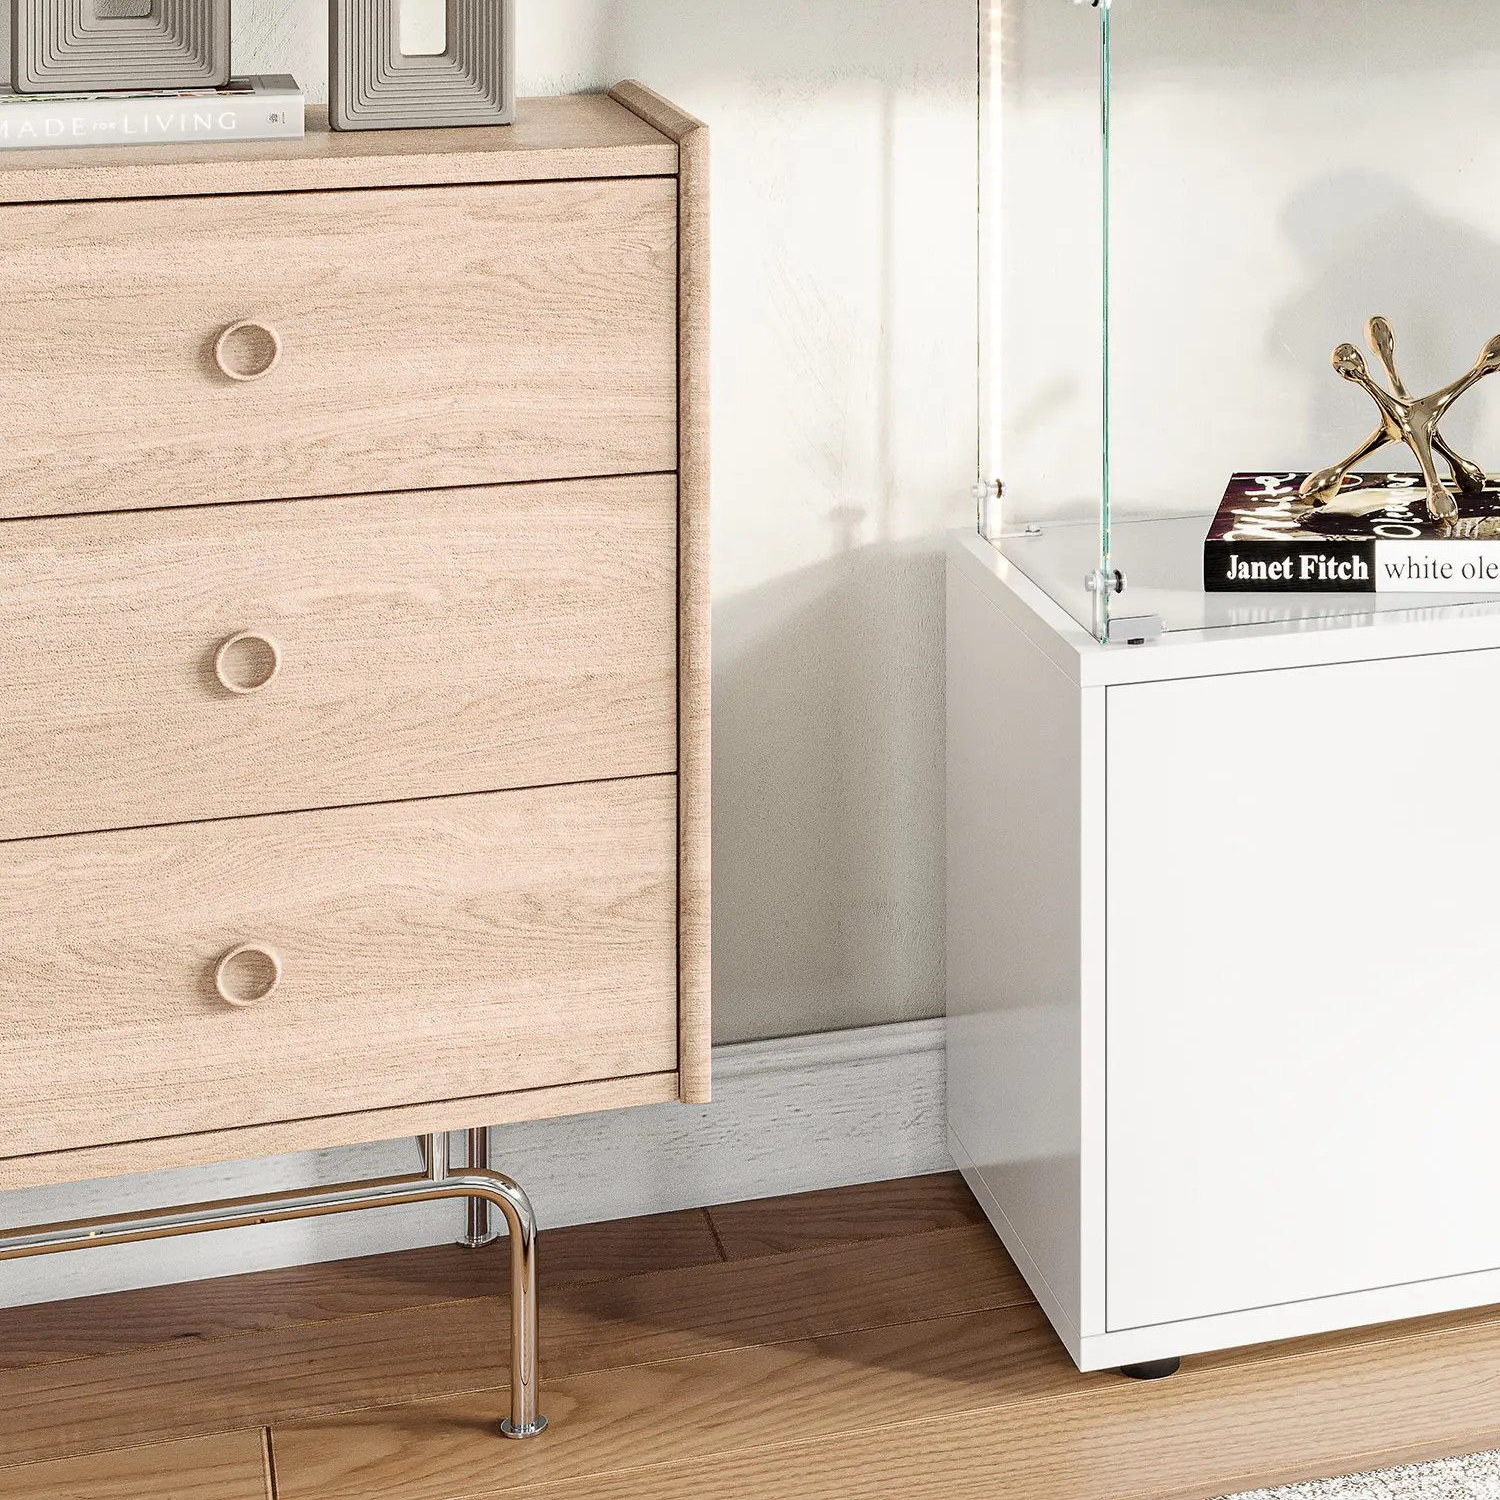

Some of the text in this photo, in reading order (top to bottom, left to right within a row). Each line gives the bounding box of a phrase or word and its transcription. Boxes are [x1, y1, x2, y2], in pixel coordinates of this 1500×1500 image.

[124, 111, 237, 134] LIVING
[1226, 554, 1293, 580] Janet
[1298, 554, 1370, 580] Fitch
[1384, 556, 1454, 580] white
